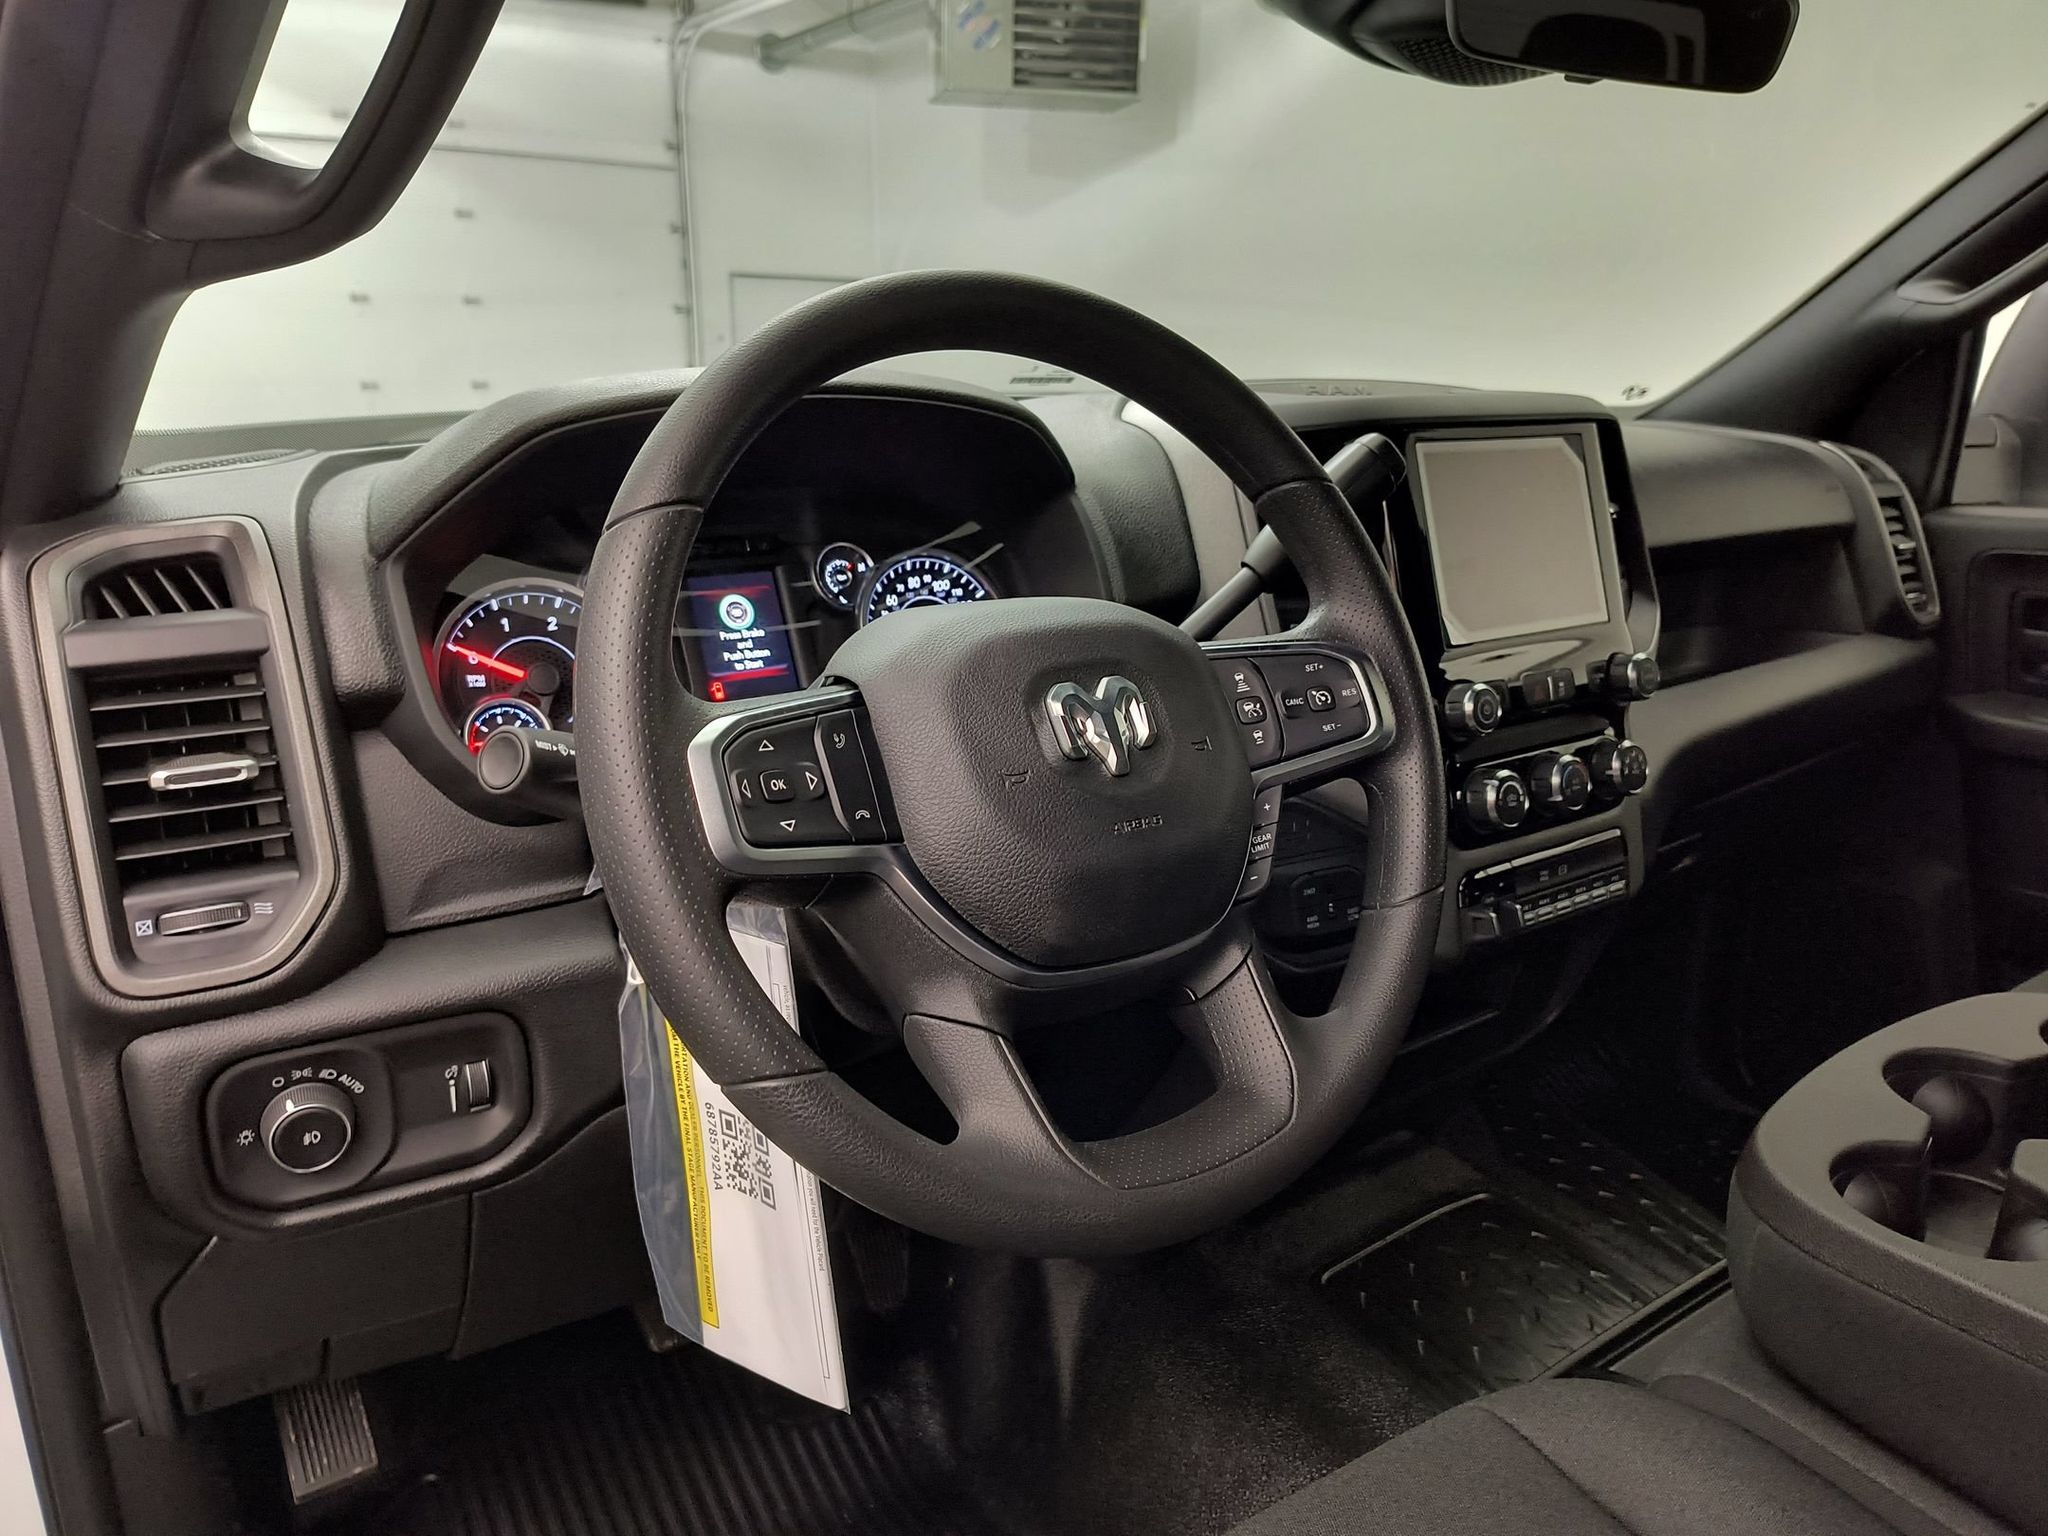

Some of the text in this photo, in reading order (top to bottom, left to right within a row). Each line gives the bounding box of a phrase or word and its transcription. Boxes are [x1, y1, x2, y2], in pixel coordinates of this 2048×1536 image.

[896, 584, 905, 593] 70
[907, 576, 921, 589] 80
[931, 579, 950, 592] 100
[951, 588, 963, 597] 110
[886, 594, 898, 606] 60
[500, 617, 510, 633] 1
[546, 616, 559, 632] 2
[719, 628, 765, 640] Press Brake
[737, 639, 753, 649] and
[723, 649, 771, 661] Push Button
[735, 660, 764, 670] to Start
[1341, 688, 1357, 697] RES
[1285, 697, 1304, 706] CANC
[770, 779, 787, 791] OK
[1252, 833, 1272, 844] GEAR
[1251, 842, 1270, 853] LIMIT
[673, 1043, 682, 1058] THE
[675, 1061, 684, 1092] VEHICLE
[338, 1073, 365, 1094] AUTO
[679, 1093, 686, 1104] BY
[684, 1083, 693, 1101] AND
[681, 1107, 690, 1121] THE
[683, 1123, 693, 1145] FINAL
[704, 1102, 724, 1191] 68785792AA
[687, 1147, 696, 1173] STAGE
[689, 1174, 701, 1238] MANUFACTURER
[700, 1206, 709, 1249] DOCUMENT
[815, 1235, 823, 1252] Vehicle
[702, 1252, 710, 1262] TO
[817, 1253, 825, 1272] Placard
[703, 1264, 711, 1274] BE
[705, 1275, 714, 1313] REMOVED
